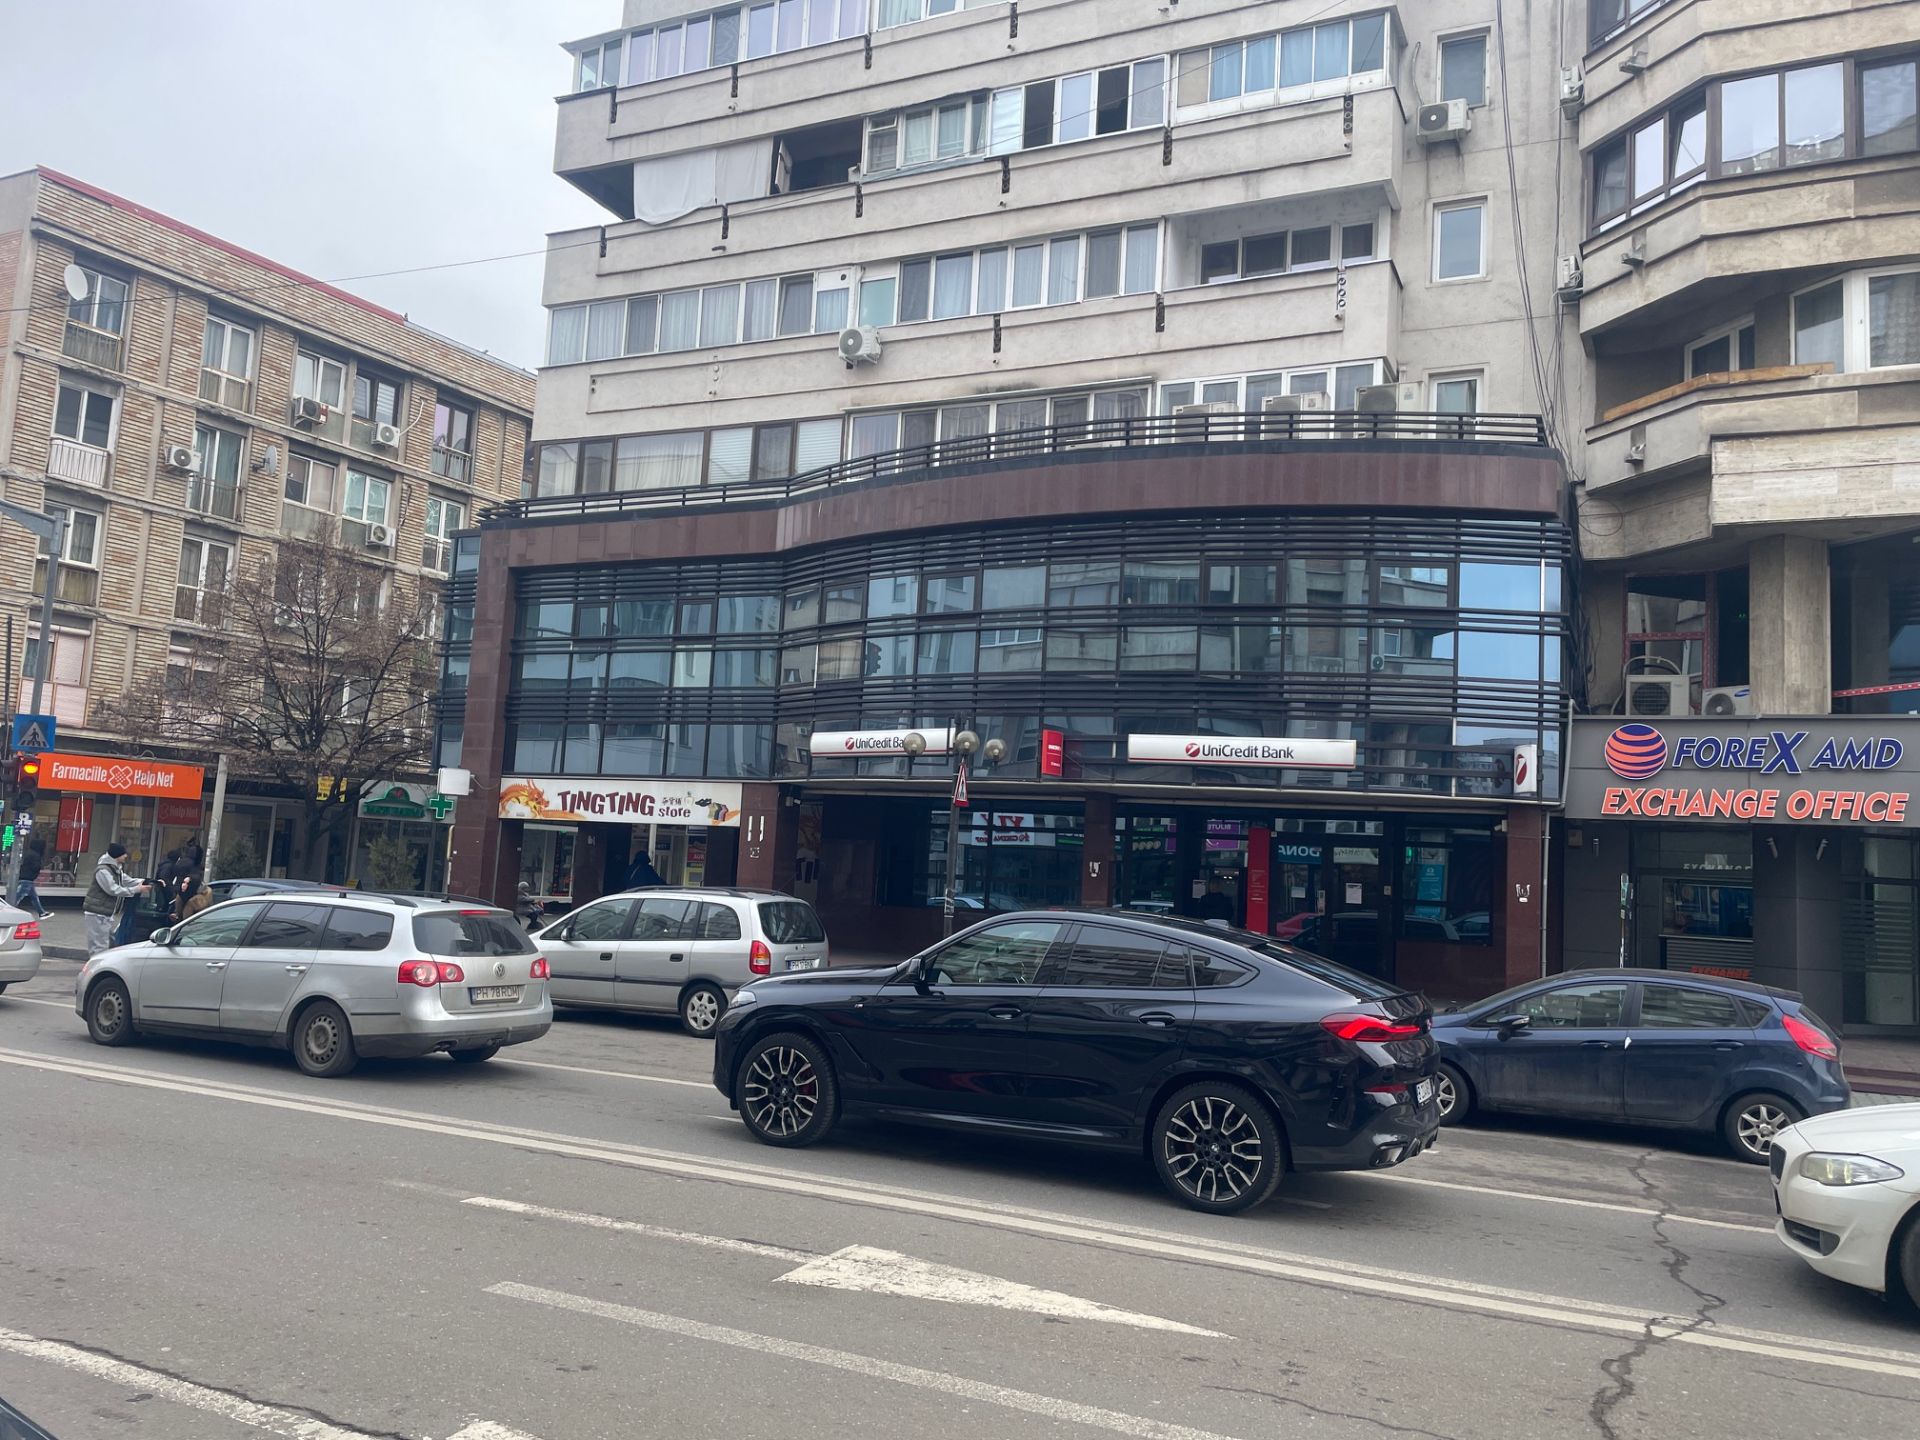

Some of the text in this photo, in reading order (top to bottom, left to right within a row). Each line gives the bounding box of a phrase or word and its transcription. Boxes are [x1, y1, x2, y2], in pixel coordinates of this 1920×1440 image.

[855, 737, 892, 750] UniCredit
[1202, 744, 1294, 759] UniCredit Bank
[1809, 737, 1904, 769] AMD
[52, 762, 174, 788] Farmaciile Help Net
[658, 806, 691, 818] store
[1601, 787, 1910, 822] EXCHANGE OFFICE
